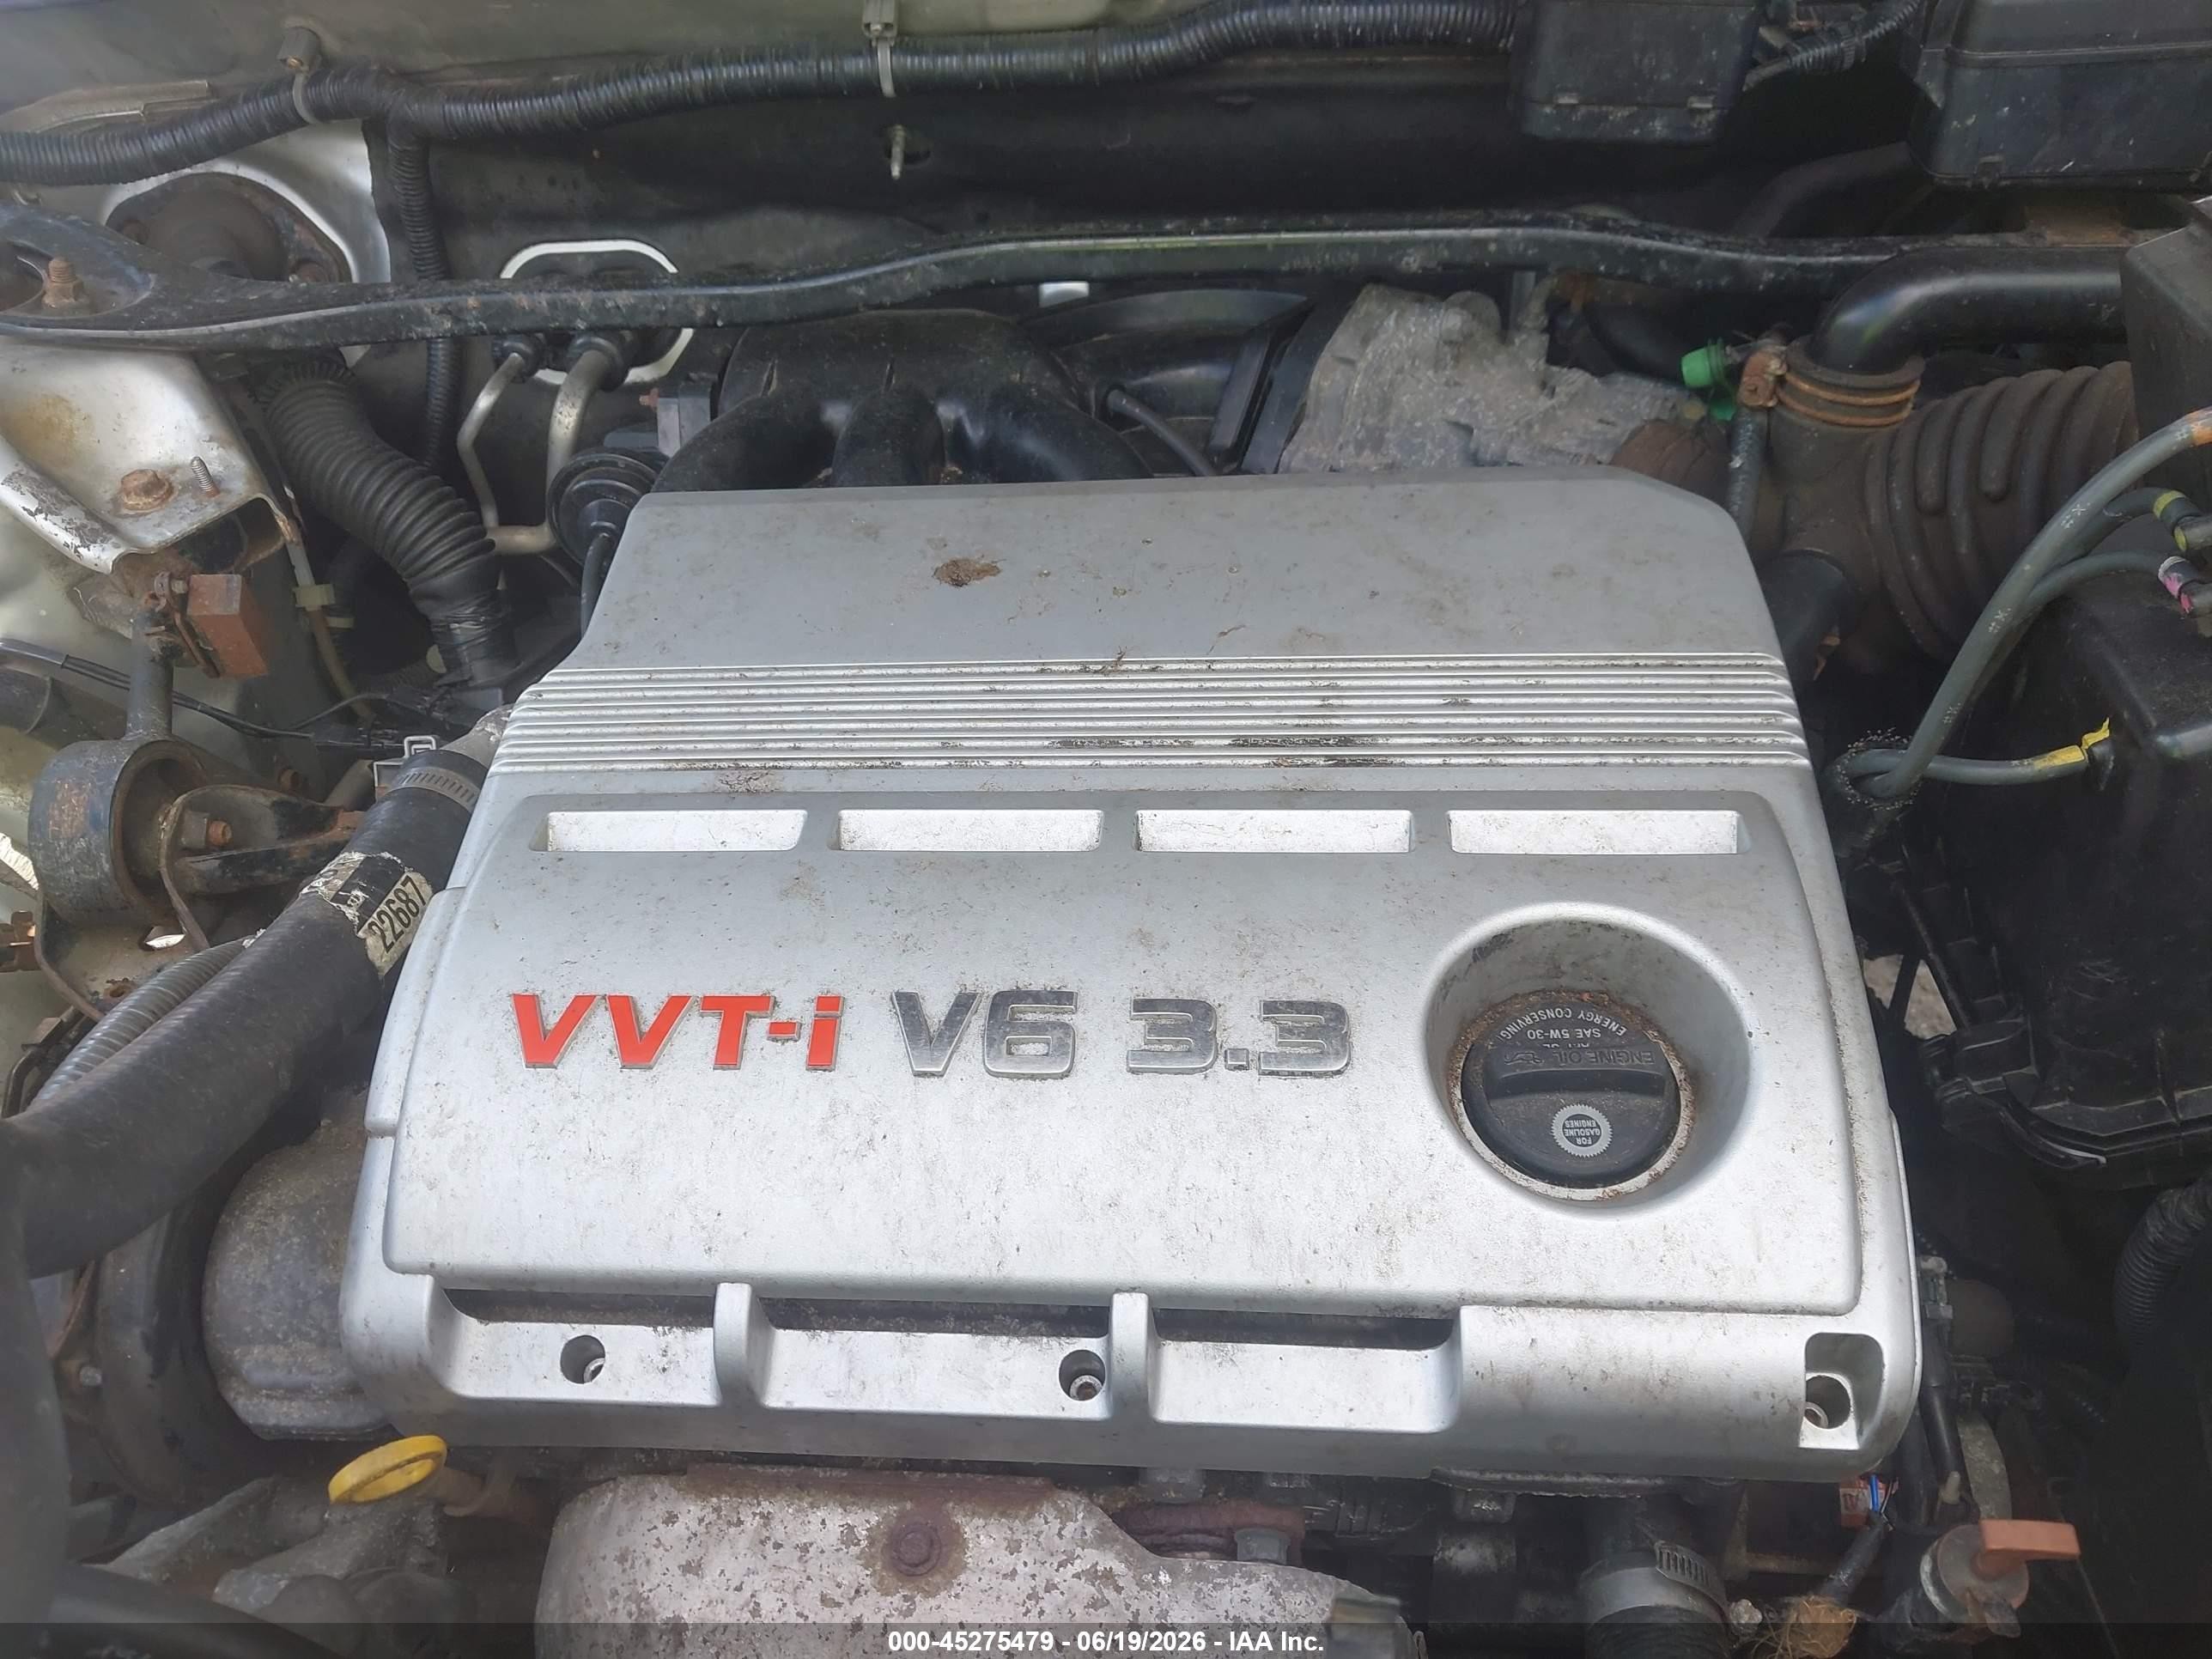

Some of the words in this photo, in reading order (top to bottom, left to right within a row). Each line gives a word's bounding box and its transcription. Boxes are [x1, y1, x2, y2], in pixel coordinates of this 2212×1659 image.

[368, 874, 428, 954] 22687
[1499, 1007, 1572, 1040] CONSERVING
[1577, 1009, 1627, 1036] ENERGY
[511, 993, 845, 1072] VVT-i
[890, 989, 1079, 1079] V6
[1126, 997, 1353, 1079] 3.3
[1527, 1029, 1571, 1040] 5W-30
[1574, 1028, 1601, 1038] SAE
[1553, 1050, 1582, 1065] OIL
[1586, 1049, 1655, 1065] ENGINE
[1565, 1120, 1596, 1128] ENGINES
[1563, 1127, 1601, 1137] GASOLINE
[1576, 1136, 1593, 1145] FOR
